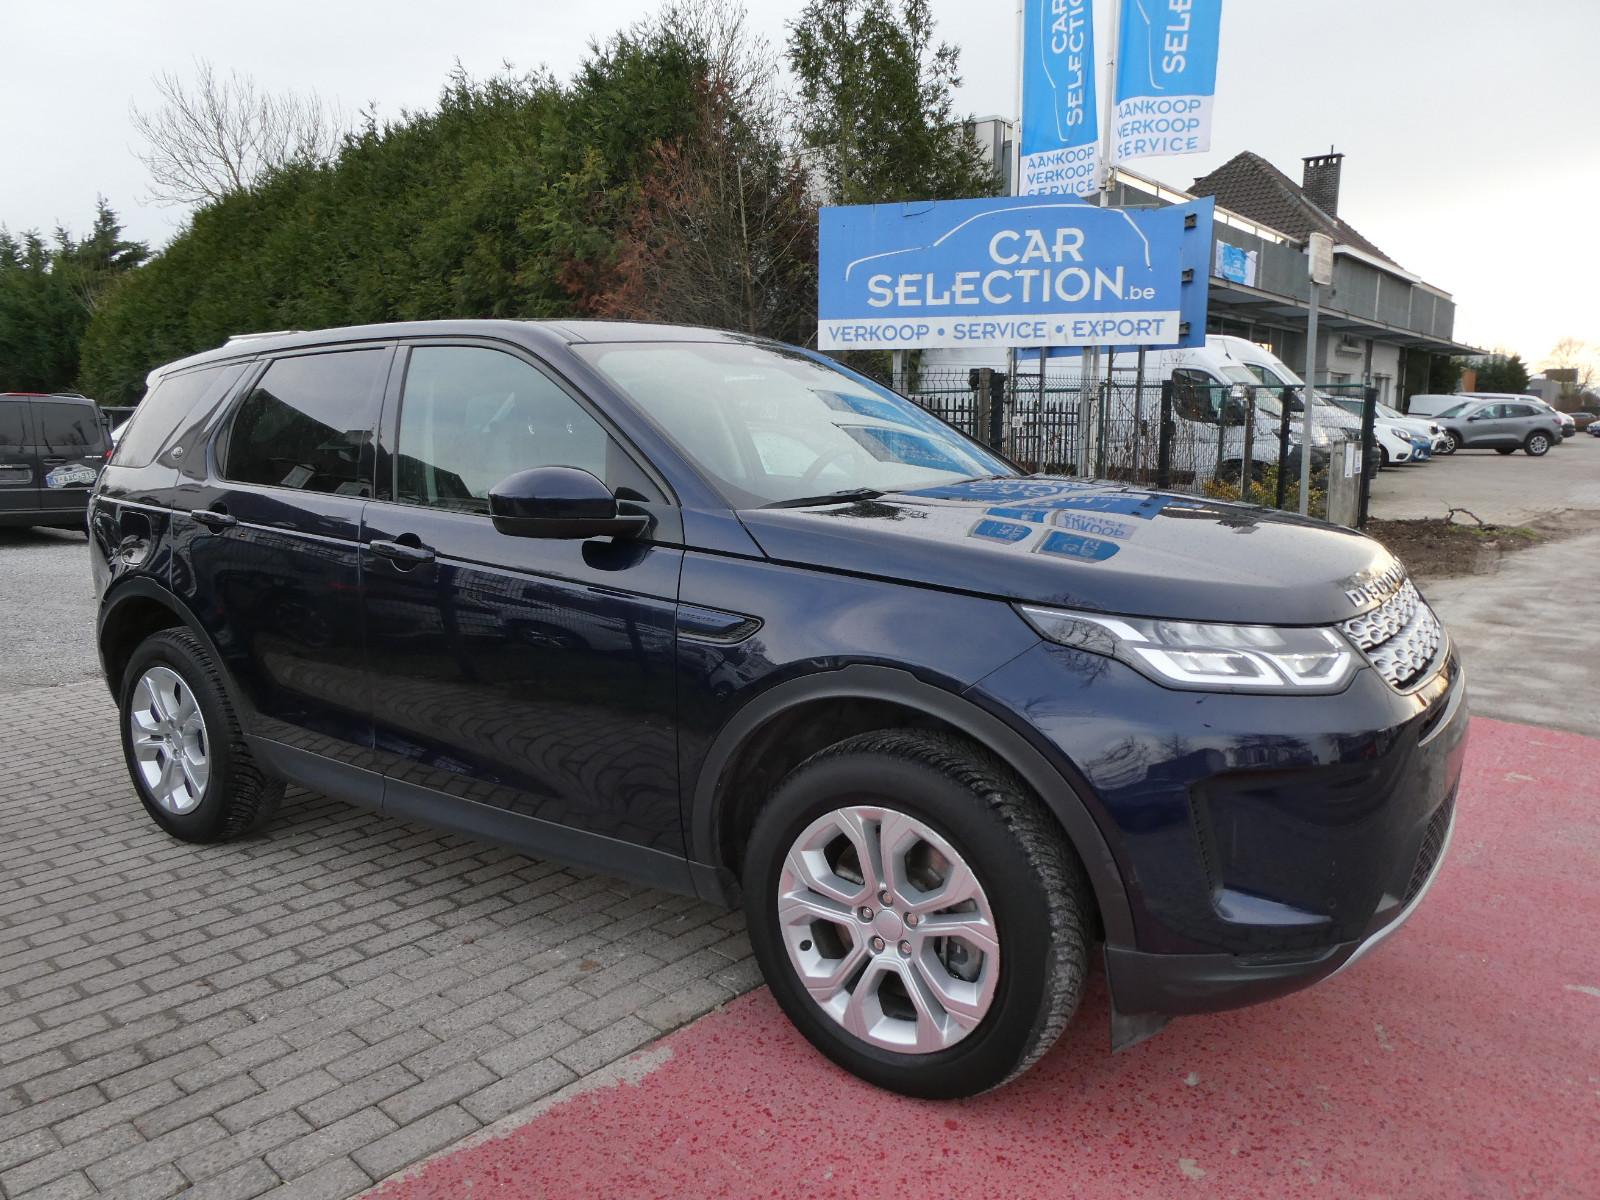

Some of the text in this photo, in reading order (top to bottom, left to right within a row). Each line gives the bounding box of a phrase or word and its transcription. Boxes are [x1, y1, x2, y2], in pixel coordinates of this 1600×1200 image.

[1118, 99, 1201, 119] AANKOOP
[1118, 118, 1200, 139] VERKOOP
[1027, 146, 1095, 170] AANKOOP
[1118, 136, 1199, 159] SERVICE
[1027, 163, 1095, 185] VERKOOP
[989, 227, 1085, 266] CAR
[829, 318, 1166, 343] VERKOOP SERVICE EXPORT
